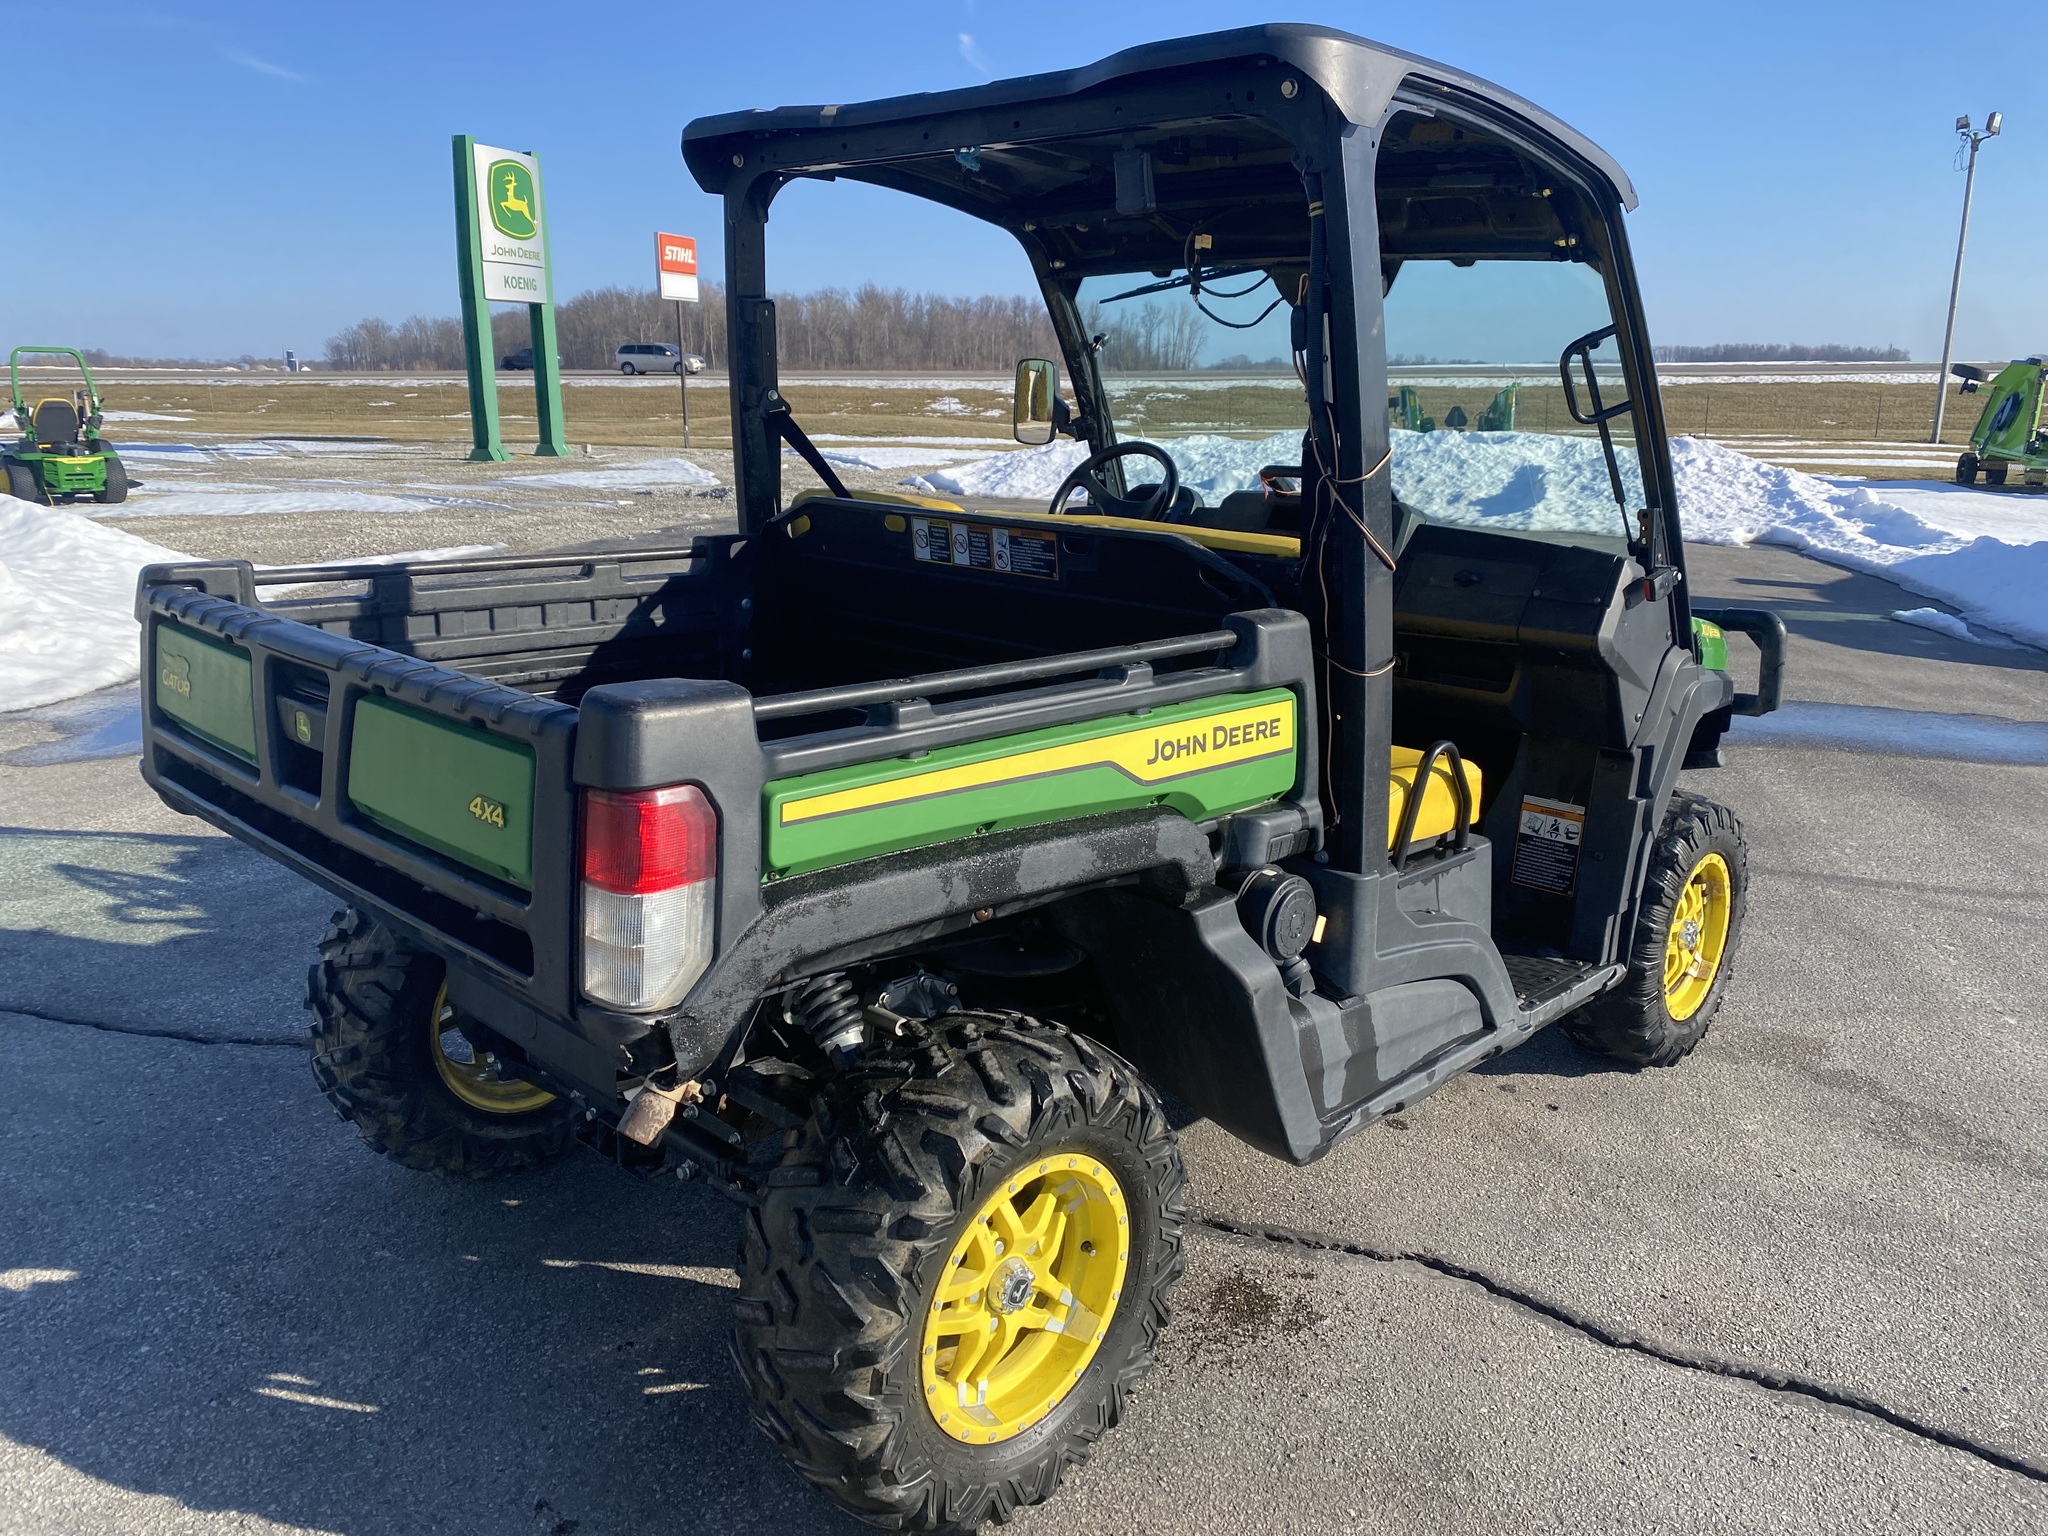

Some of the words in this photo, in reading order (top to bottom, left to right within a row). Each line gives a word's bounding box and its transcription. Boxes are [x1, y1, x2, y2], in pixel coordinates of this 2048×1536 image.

[491, 244, 517, 259] JOHN
[517, 246, 540, 261] DEERE
[664, 245, 695, 264] STIHL
[503, 275, 537, 291] KOENIG
[162, 668, 191, 699] GATOR
[1147, 732, 1207, 765] JOHN
[1212, 717, 1281, 750] DEERE
